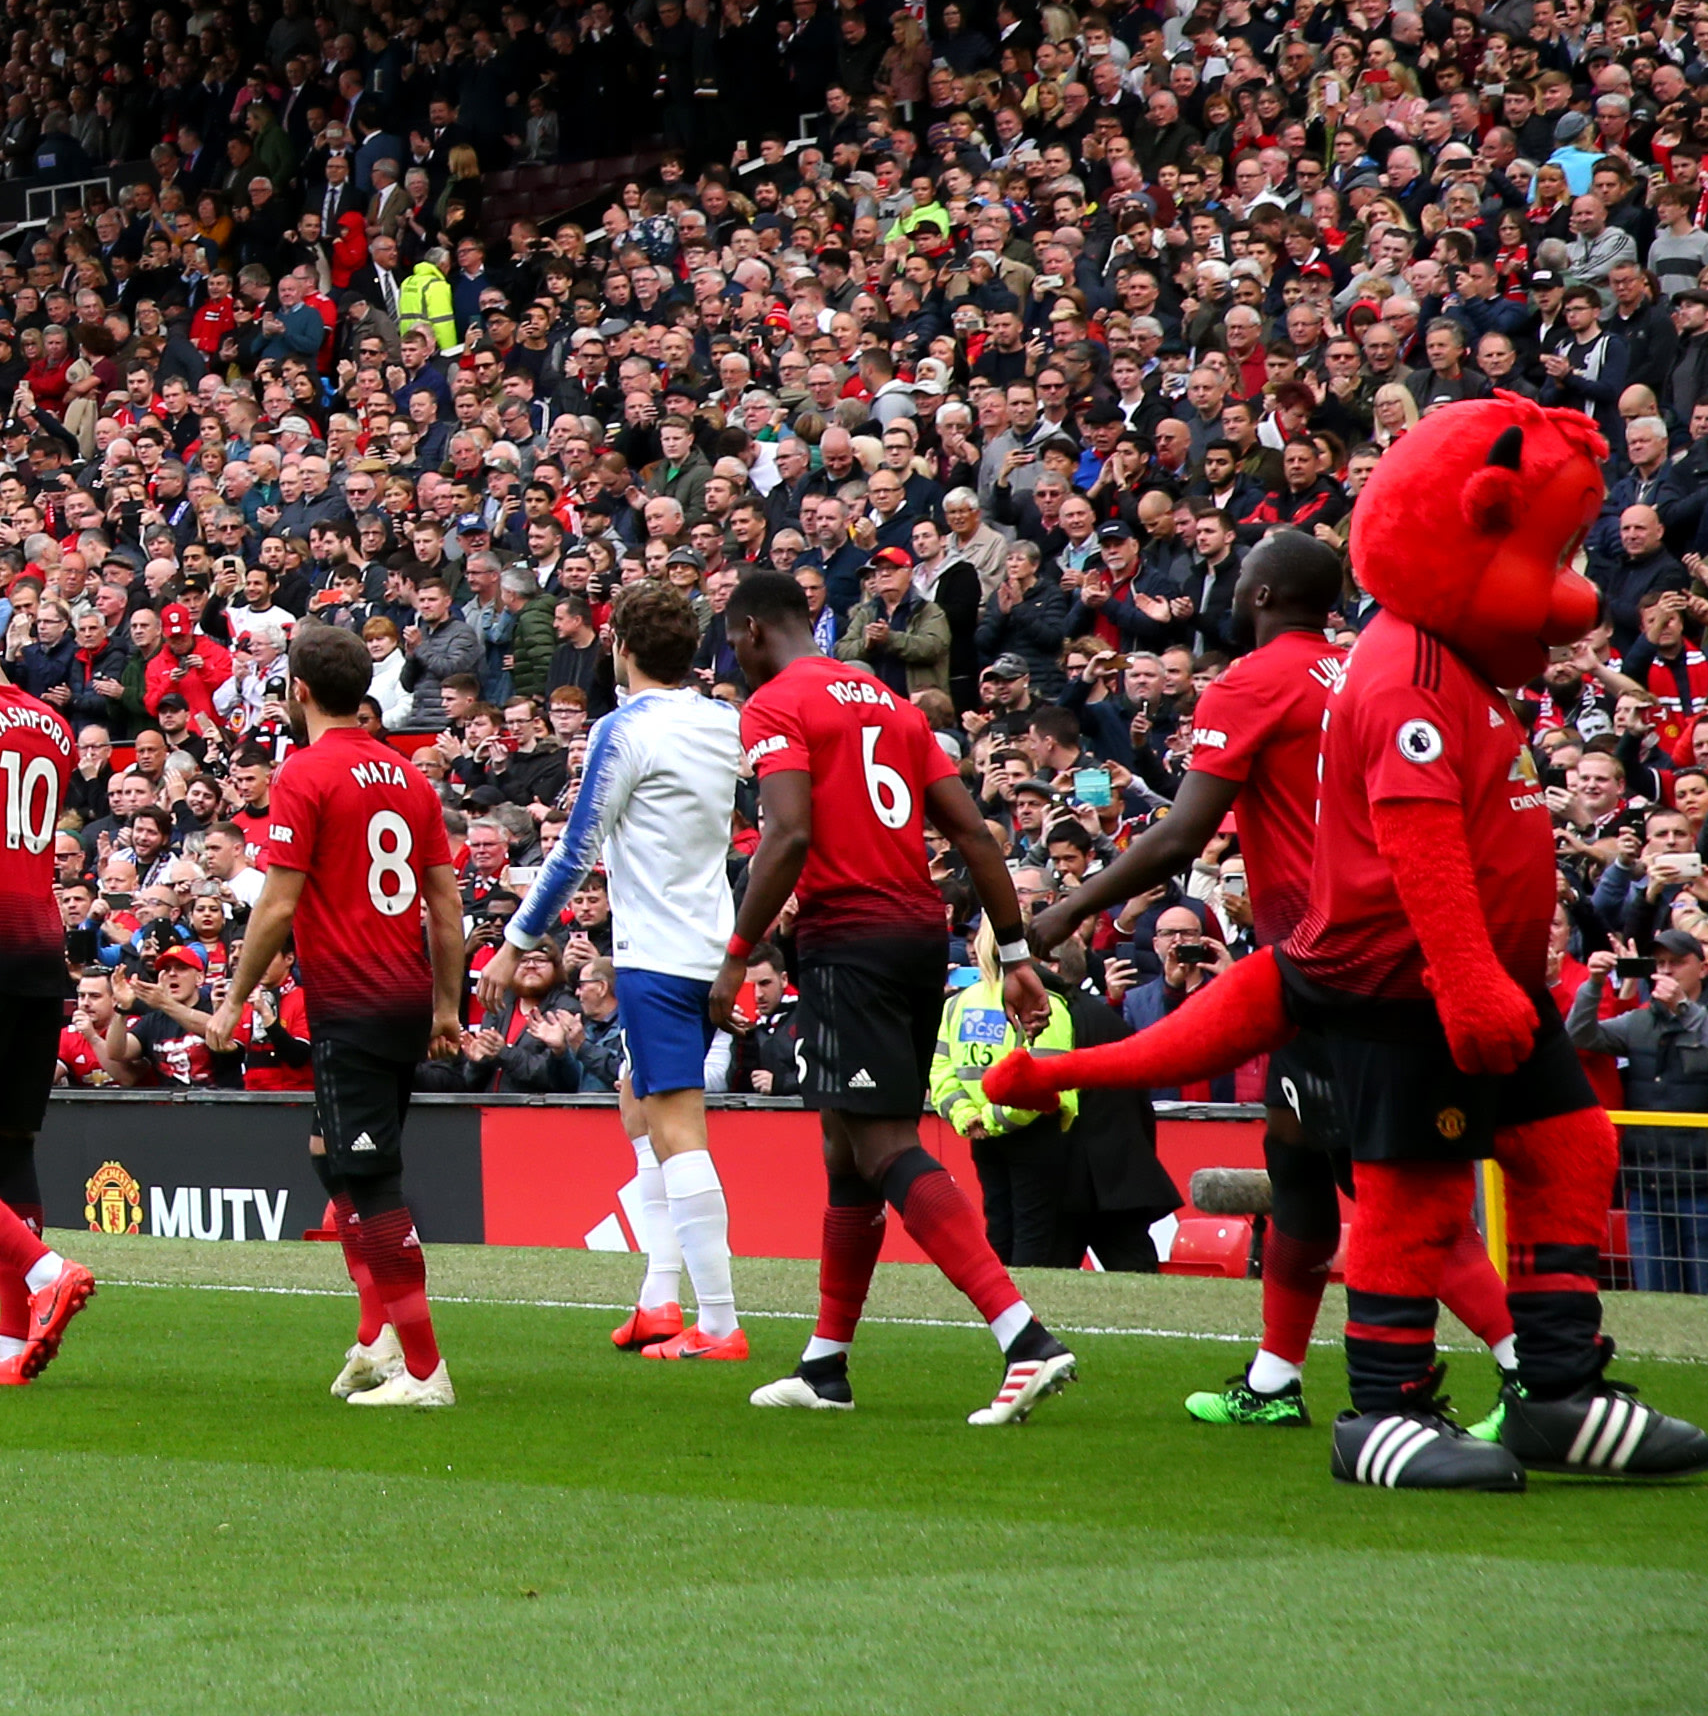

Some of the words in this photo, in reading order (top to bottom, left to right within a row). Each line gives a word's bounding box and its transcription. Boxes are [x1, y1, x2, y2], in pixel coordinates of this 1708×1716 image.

[826, 680, 897, 712] POGBA
[350, 761, 408, 790] MATA
[861, 725, 913, 830] 6
[0, 750, 59, 855] 10
[367, 809, 417, 916] 8
[975, 1022, 1005, 1038] CSG
[88, 1167, 136, 1199] MANCHESTER
[150, 1186, 289, 1242] MUTV
